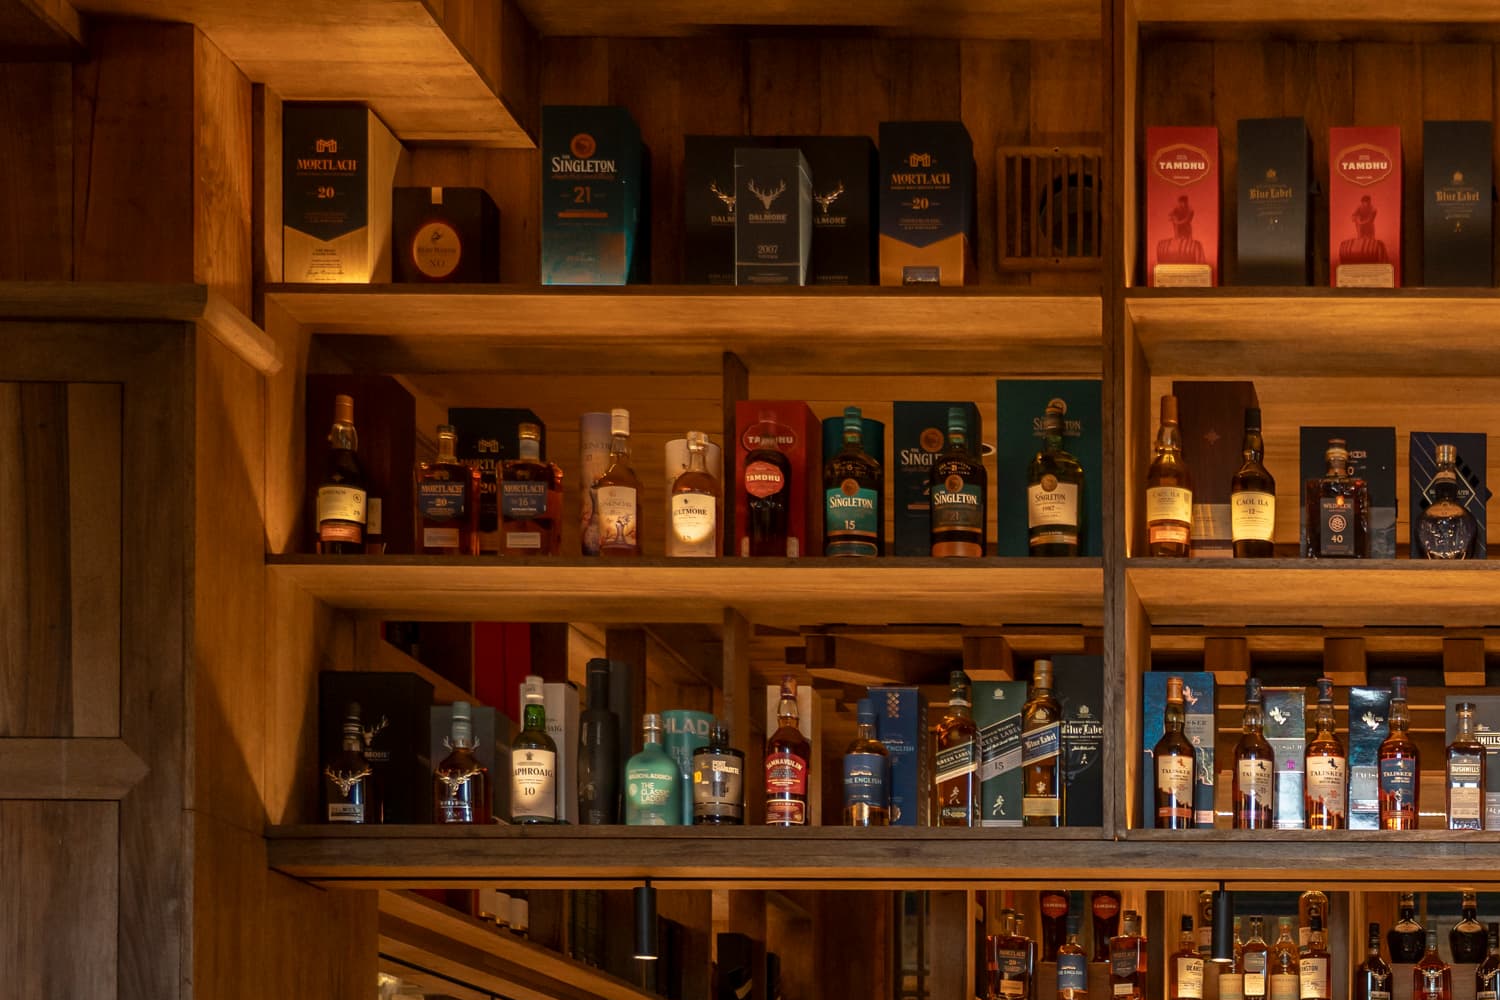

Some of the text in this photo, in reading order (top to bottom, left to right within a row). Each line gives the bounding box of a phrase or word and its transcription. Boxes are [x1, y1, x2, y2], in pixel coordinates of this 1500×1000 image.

[296, 158, 358, 171] MORTLACH
[551, 156, 616, 174] SINGLETON
[1158, 160, 1206, 172] TAMDHU
[1341, 160, 1389, 172] TAMDHU
[890, 172, 951, 186] MORTLACH
[317, 186, 335, 199] 20
[573, 186, 592, 203] 21
[911, 197, 930, 211] 20
[745, 473, 781, 483] TAMDHU
[829, 495, 874, 509] SINGLETON
[934, 493, 978, 506] SINGLETON
[1236, 498, 1269, 507] CAOL ILA
[844, 520, 856, 530] 15
[1330, 535, 1343, 543] 40
[994, 761, 1004, 770] 15
[524, 787, 536, 796] 10
